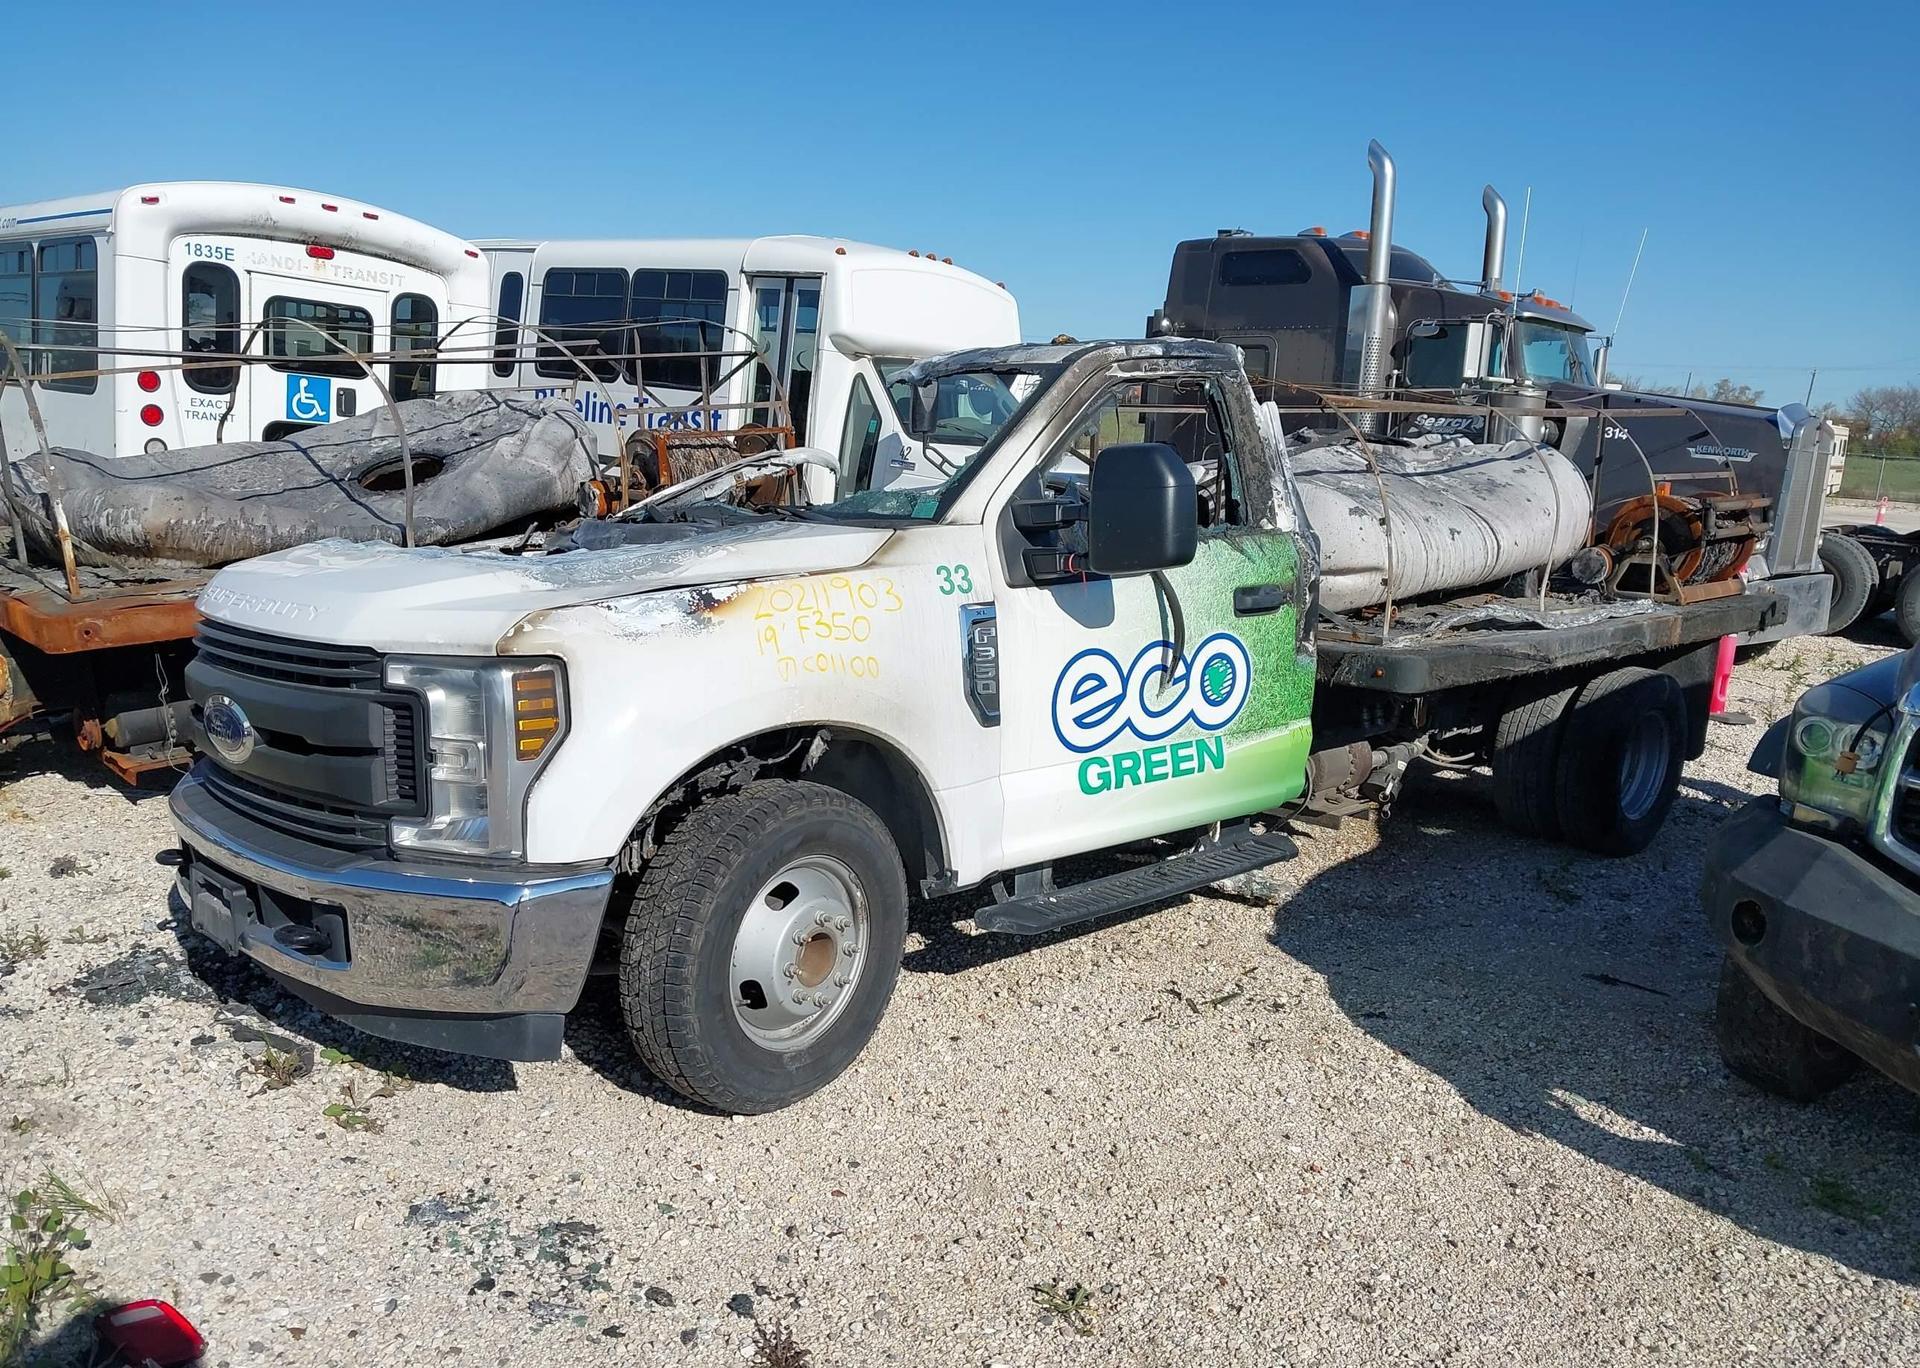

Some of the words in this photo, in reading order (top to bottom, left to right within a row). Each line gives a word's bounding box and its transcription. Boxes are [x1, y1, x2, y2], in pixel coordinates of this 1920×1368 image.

[185, 242, 235, 262] 1835E
[329, 264, 405, 287] TRANSIT
[190, 397, 231, 410] EXACT
[1414, 413, 1472, 431] Searcy
[1604, 426, 1628, 440] 314
[899, 445, 912, 461] 42
[1696, 444, 1750, 459] KENWORTH
[936, 564, 973, 595] 33
[755, 576, 904, 620] 20211903
[796, 609, 871, 644] F350
[1051, 632, 1252, 754] eco
[1077, 735, 1226, 795] GREEN
